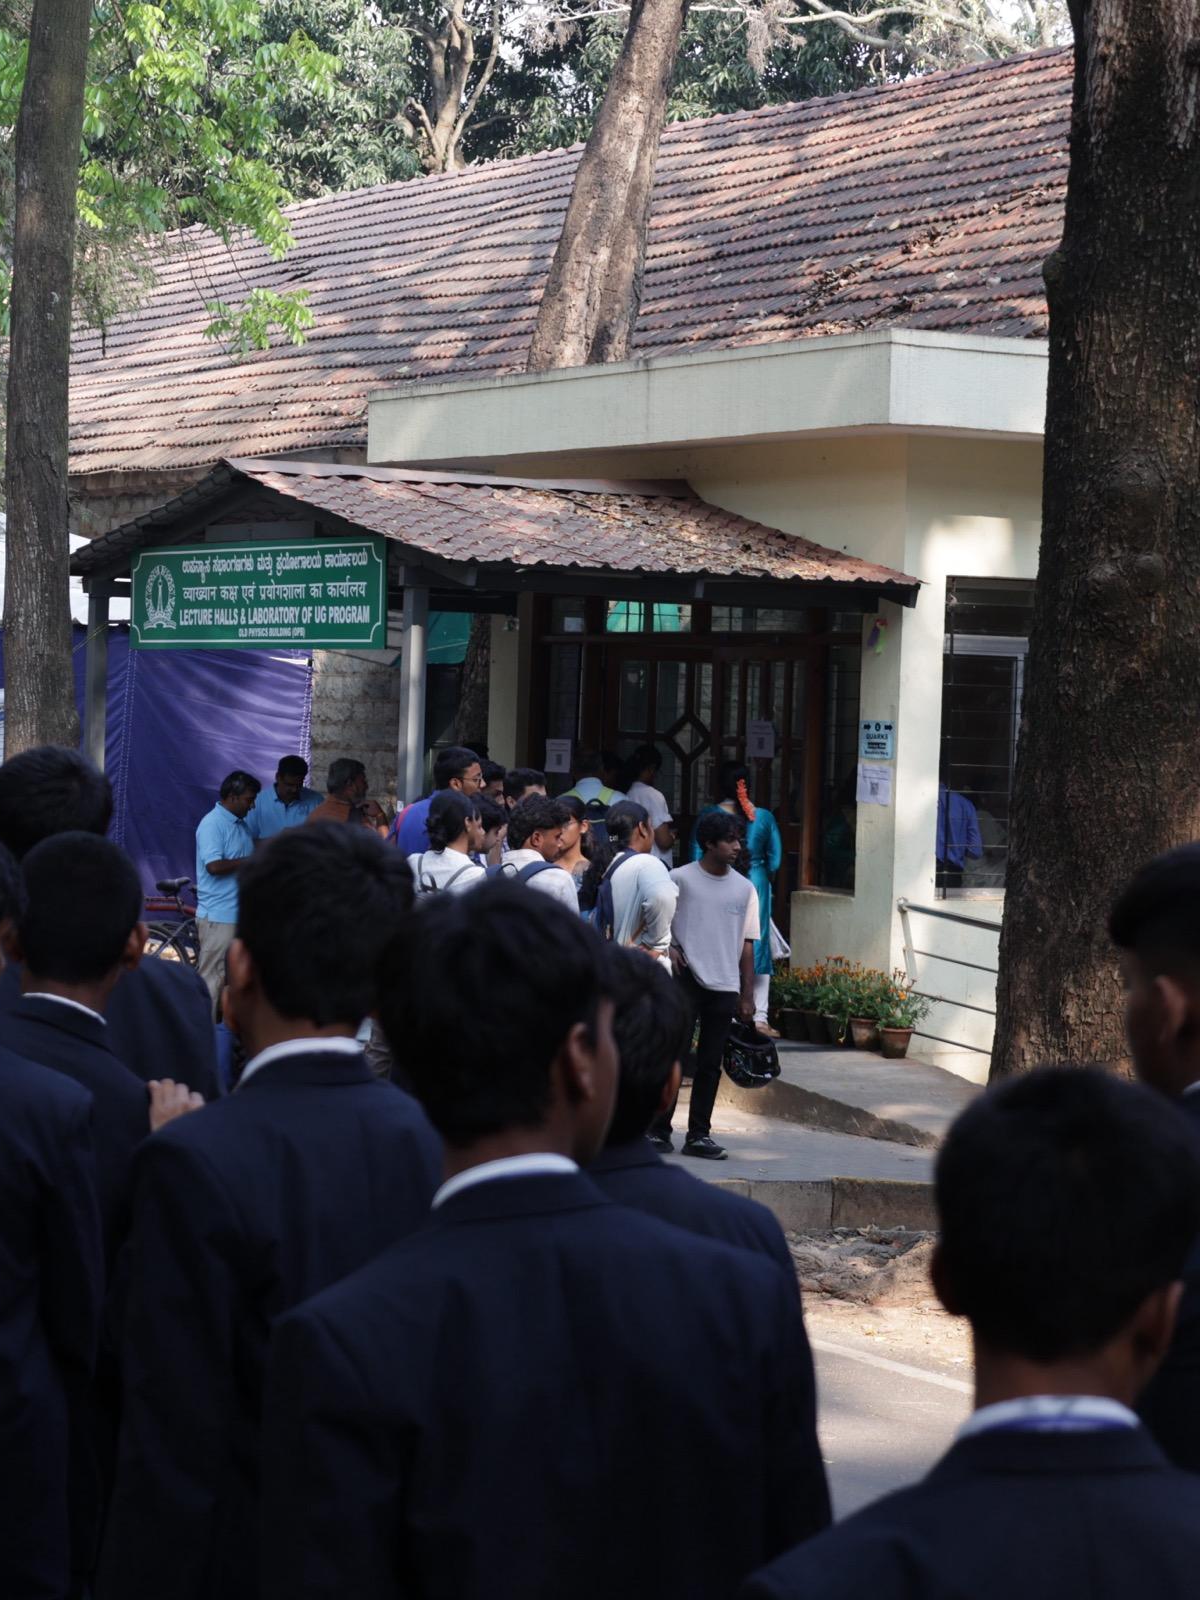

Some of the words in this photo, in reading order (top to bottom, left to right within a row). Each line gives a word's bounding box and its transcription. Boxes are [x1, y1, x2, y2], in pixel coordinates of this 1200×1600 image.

[182, 586, 217, 602] व्याख्यान
[219, 586, 239, 603] कक्ष
[241, 581, 256, 604] एवं
[259, 579, 306, 601] प्रयोगशाला
[309, 583, 323, 598] का
[326, 576, 367, 598] कार्यालय
[179, 608, 213, 626] LECTURE
[214, 608, 238, 625] HALLS
[240, 608, 246, 625] &
[248, 606, 300, 624] LABORATORY
[301, 606, 313, 624] OF
[314, 605, 327, 624] UG
[328, 605, 370, 624] PROGRAM
[238, 628, 248, 638] OLD
[248, 627, 268, 637] PHYSICS
[269, 627, 291, 637] BUILDING
